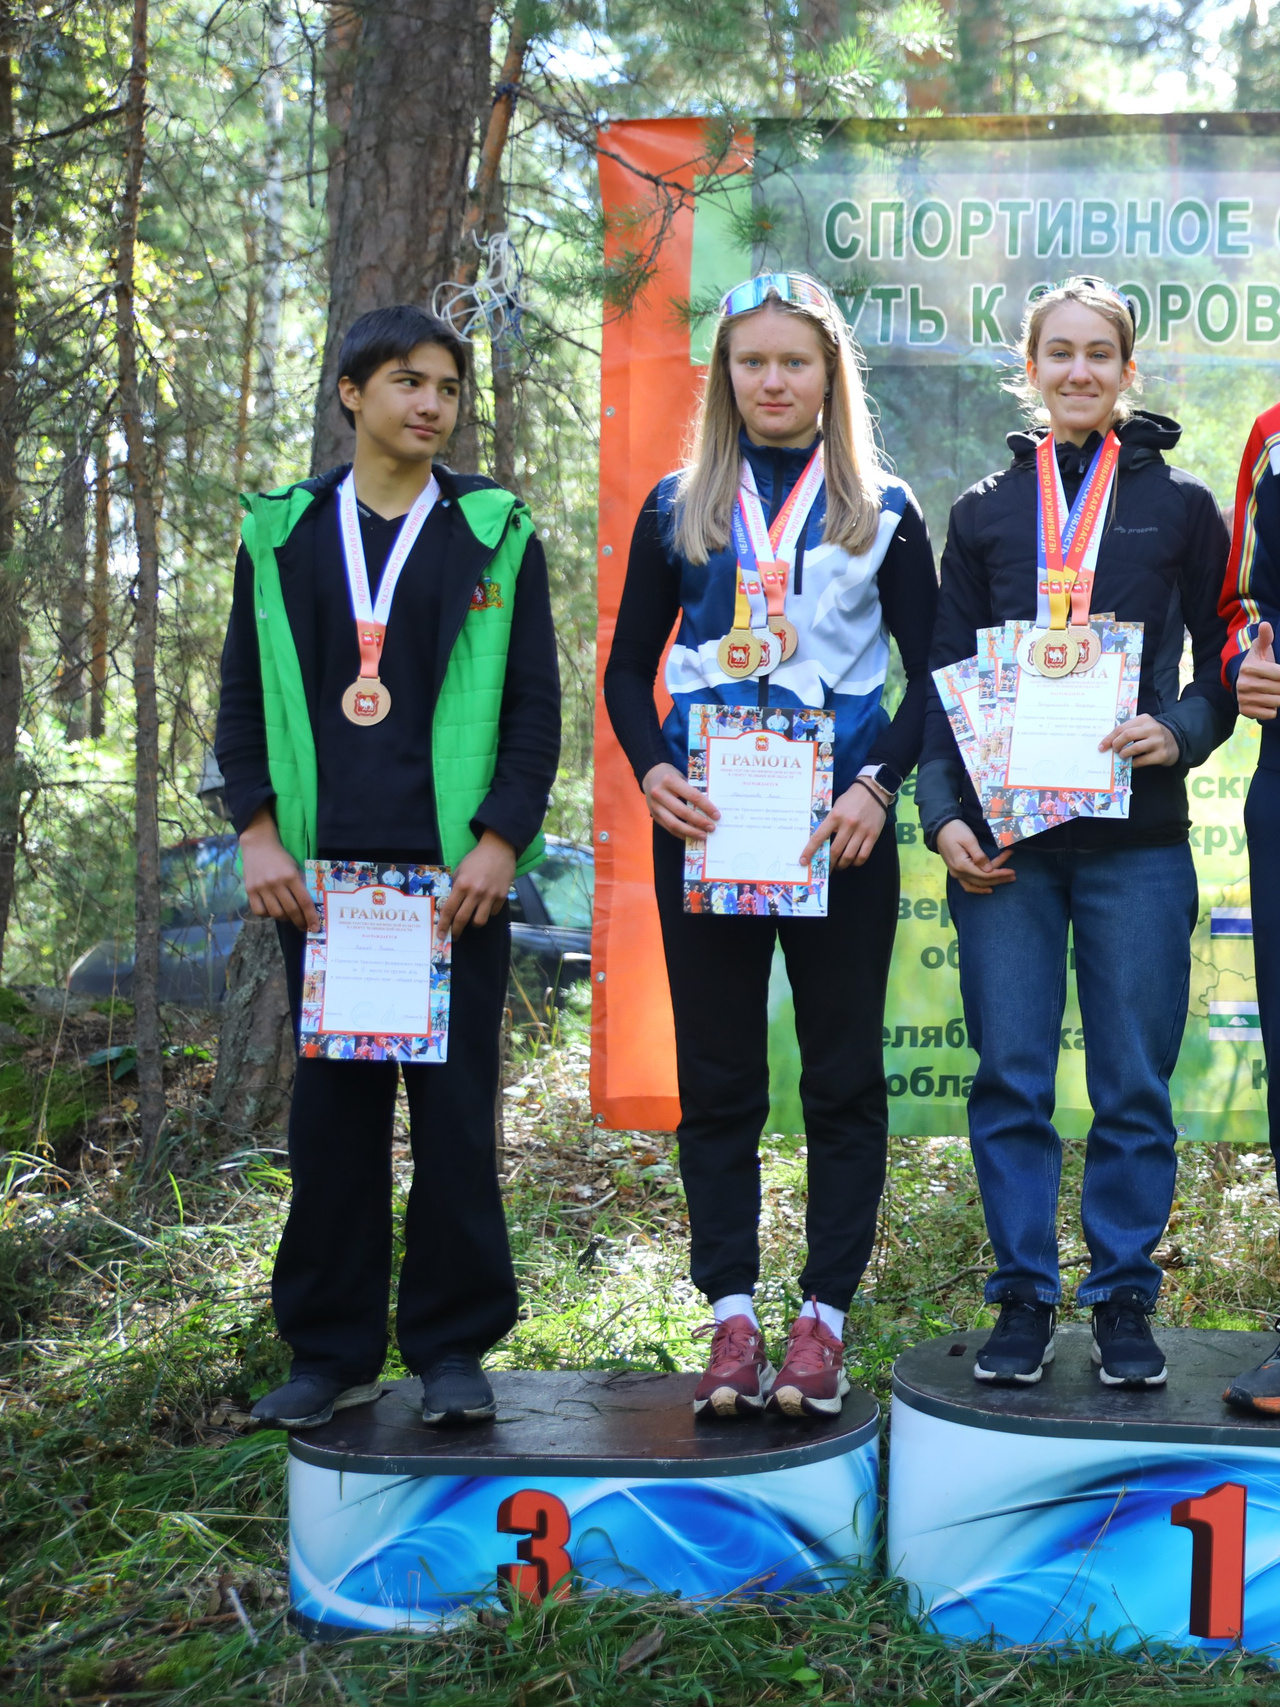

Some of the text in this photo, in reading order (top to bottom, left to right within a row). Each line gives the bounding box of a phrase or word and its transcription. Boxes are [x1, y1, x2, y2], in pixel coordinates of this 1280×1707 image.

[825, 197, 1253, 260] СПОРТИВНОЕ
[832, 284, 948, 346] УТЬ
[970, 283, 1007, 346] К
[1041, 448, 1057, 554] ЧЕЛЯБИНСКАЯ ОБЛАСТЬ
[1088, 449, 1115, 511] ЧЕЛЯБИНСКАЯ
[345, 498, 366, 604] ЧЕЛЯБИНСКАЯ ОБЛАСТЬ
[380, 503, 427, 604] ЧЕЛЯБИНСКАЯ ОБЛАСТЬ
[770, 515, 787, 544] ОБЛАС
[1074, 511, 1095, 553] ОБЛАСТЬ
[721, 753, 801, 768] ГРАМОТА
[339, 906, 420, 921] ГРАМОТА
[886, 1066, 974, 1098] обла
[496, 1488, 571, 1612] 3
[1170, 1480, 1247, 1640] 1
